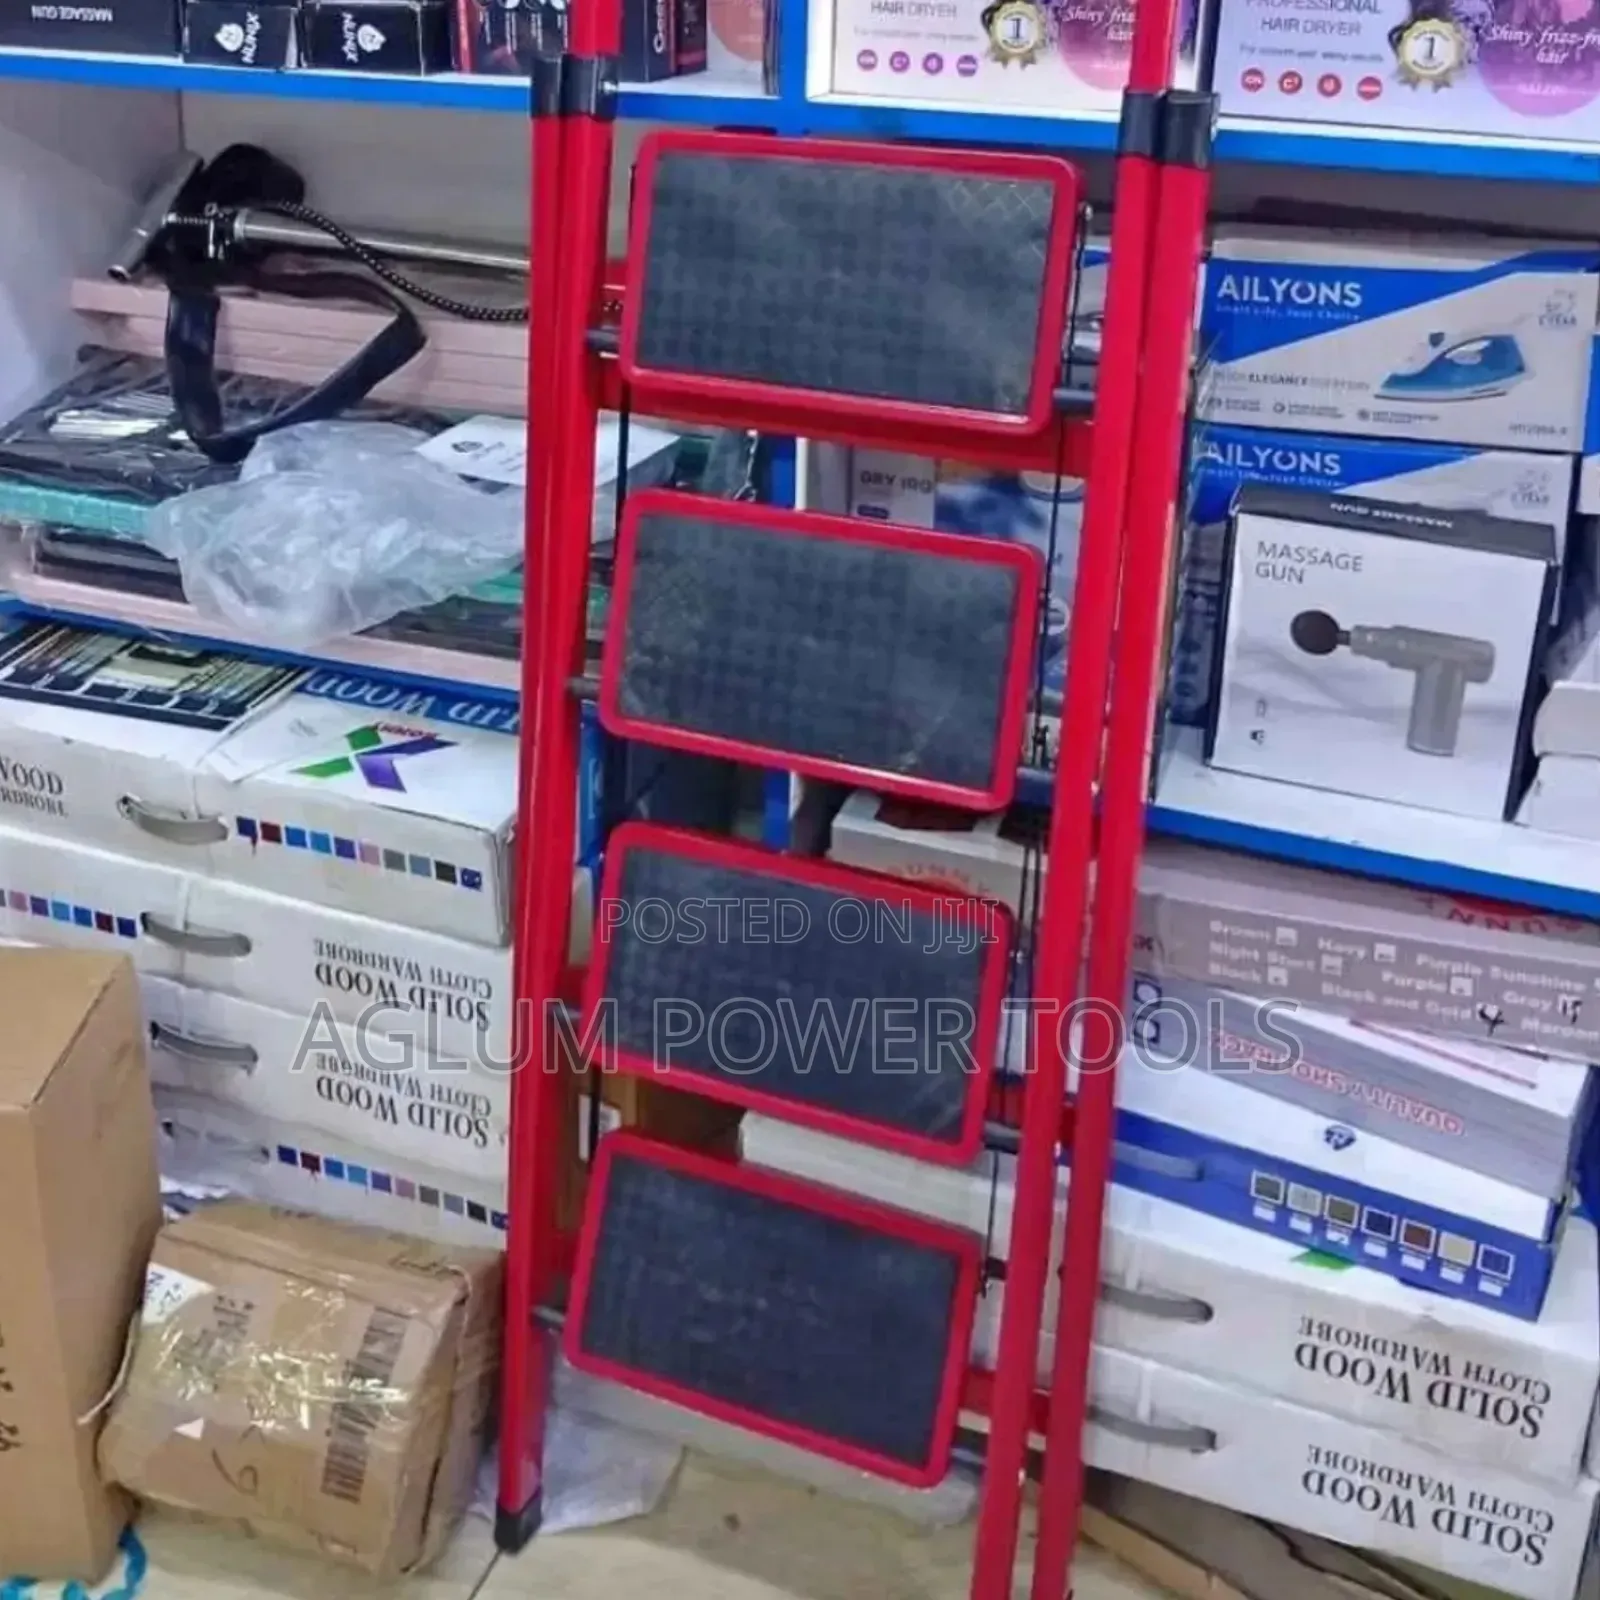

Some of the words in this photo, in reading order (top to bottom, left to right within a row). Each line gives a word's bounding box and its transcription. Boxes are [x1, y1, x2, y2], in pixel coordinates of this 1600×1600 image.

[1261, 17, 1300, 32] HAIR
[1302, 20, 1362, 36] DRYER
[1424, 36, 1437, 61] 1
[1486, 25, 1533, 45] Shiny
[1216, 274, 1363, 309] AILYONS
[1255, 561, 1306, 585] GUN
[1256, 540, 1363, 573] MASSAGE
[304, 669, 437, 718] WOOD
[314, 938, 423, 983] WARDROBE
[430, 966, 493, 1001] CLOTH
[1415, 953, 1484, 976] Purple
[314, 962, 400, 1009] WOOD
[408, 985, 490, 1033] SOLID
[316, 1052, 423, 1100] WARDROBE
[316, 1075, 399, 1125] WOOD
[430, 1083, 492, 1119] CLOTH
[1351, 1081, 1468, 1137] QUALITY
[407, 1100, 489, 1148] SOLID
[1298, 1315, 1452, 1377] WARDROBE
[1294, 1342, 1412, 1404] WOOD
[1463, 1360, 1551, 1405] CLOTH
[1426, 1378, 1545, 1439] SOLID
[1307, 1444, 1456, 1507] WARDROBE
[1301, 1469, 1418, 1530] WOOD
[1468, 1490, 1555, 1534] CLOTH
[1431, 1508, 1548, 1567] SOLID
